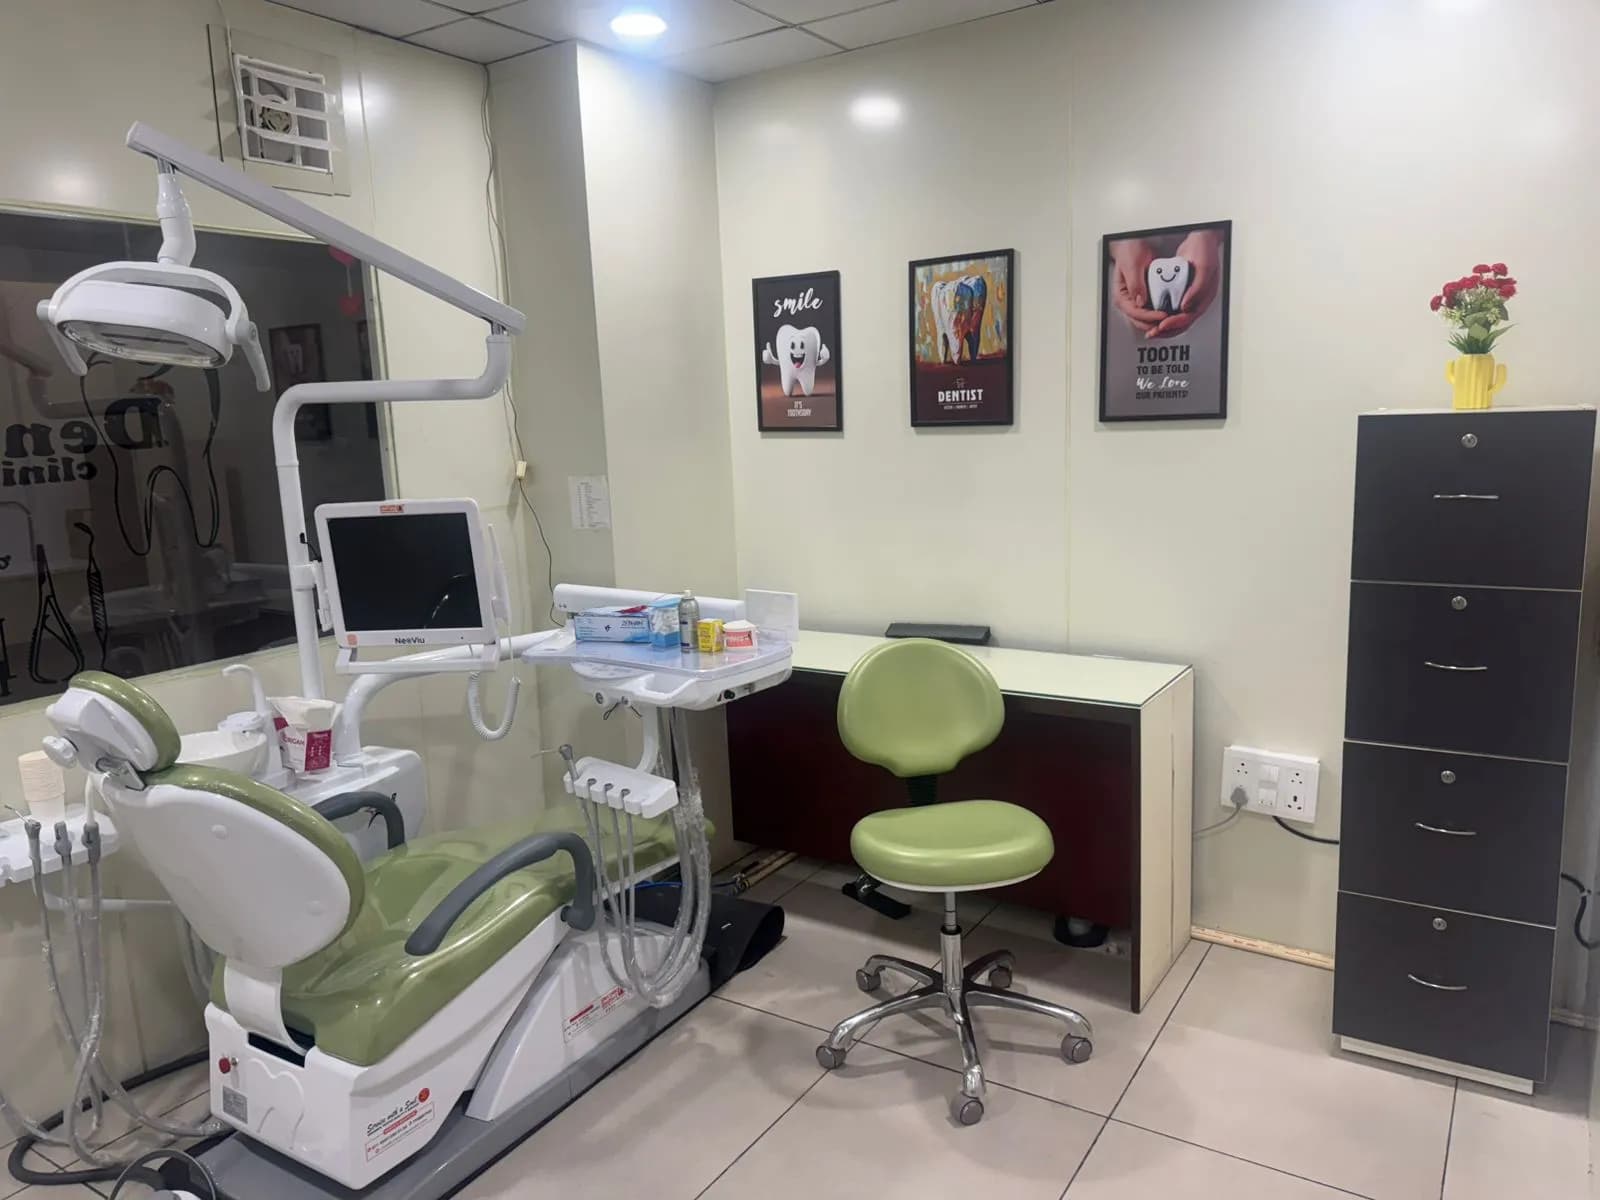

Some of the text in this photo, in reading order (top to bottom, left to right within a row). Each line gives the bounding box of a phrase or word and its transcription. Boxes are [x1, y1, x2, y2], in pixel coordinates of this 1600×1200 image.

[773, 288, 823, 318] smile
[1137, 345, 1190, 363] TOOTH
[1136, 364, 1189, 375] TO BE TOLD
[1136, 376, 1190, 390] We Love
[937, 389, 984, 402] DENTIST
